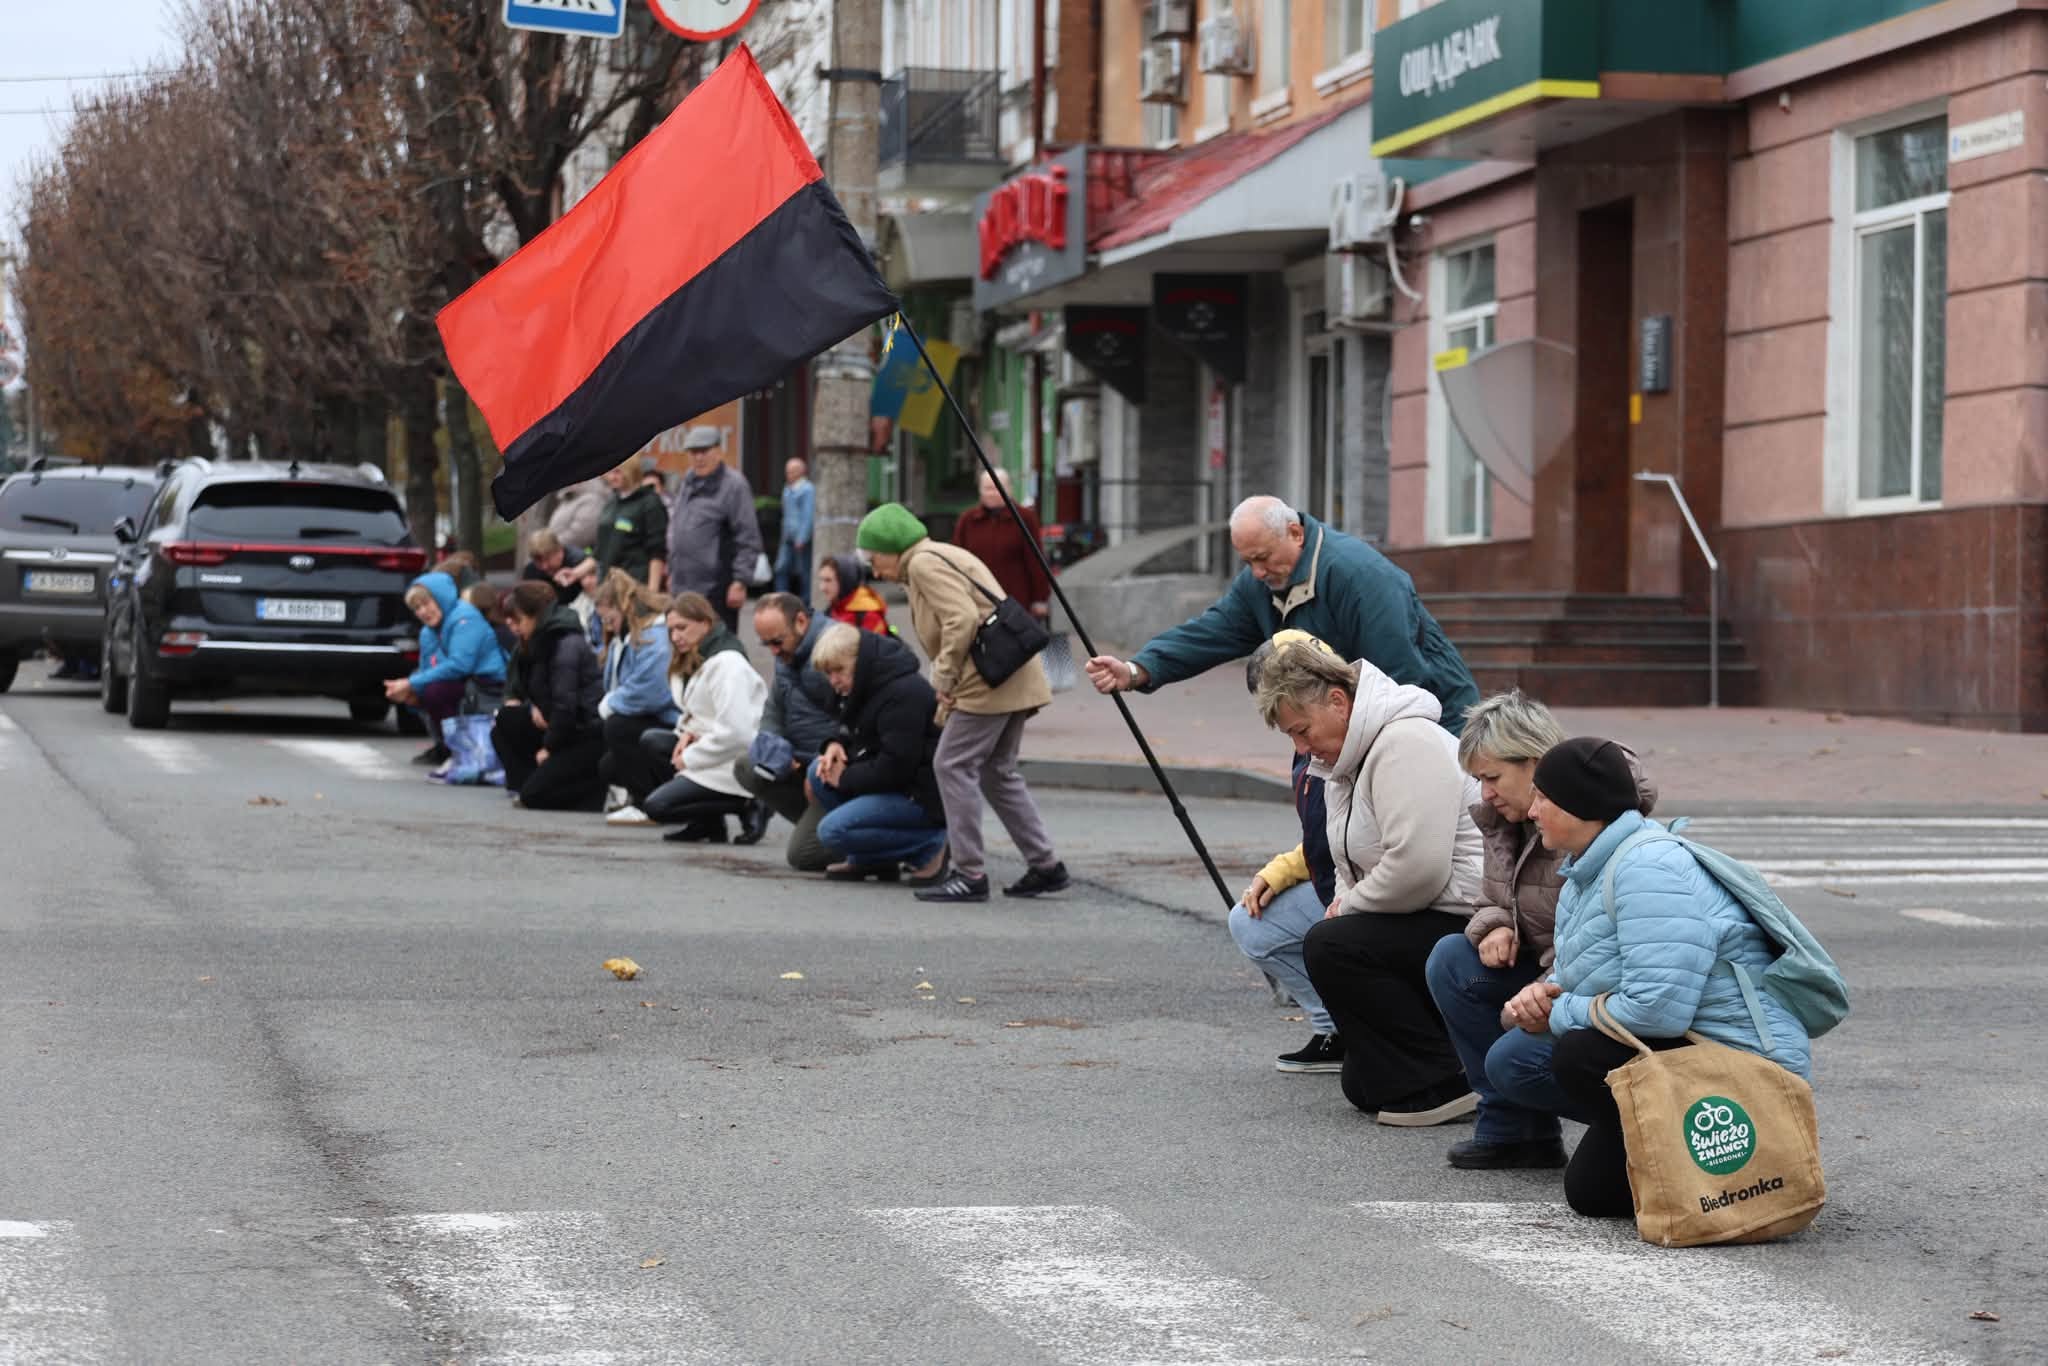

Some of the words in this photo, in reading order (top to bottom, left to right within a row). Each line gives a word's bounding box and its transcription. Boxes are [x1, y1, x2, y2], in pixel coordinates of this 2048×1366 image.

[1401, 15, 1502, 97] ОЩАДБАНК
[1697, 1138, 1749, 1161] ZNAWCY
[1700, 1175, 1784, 1214] Biedronka
